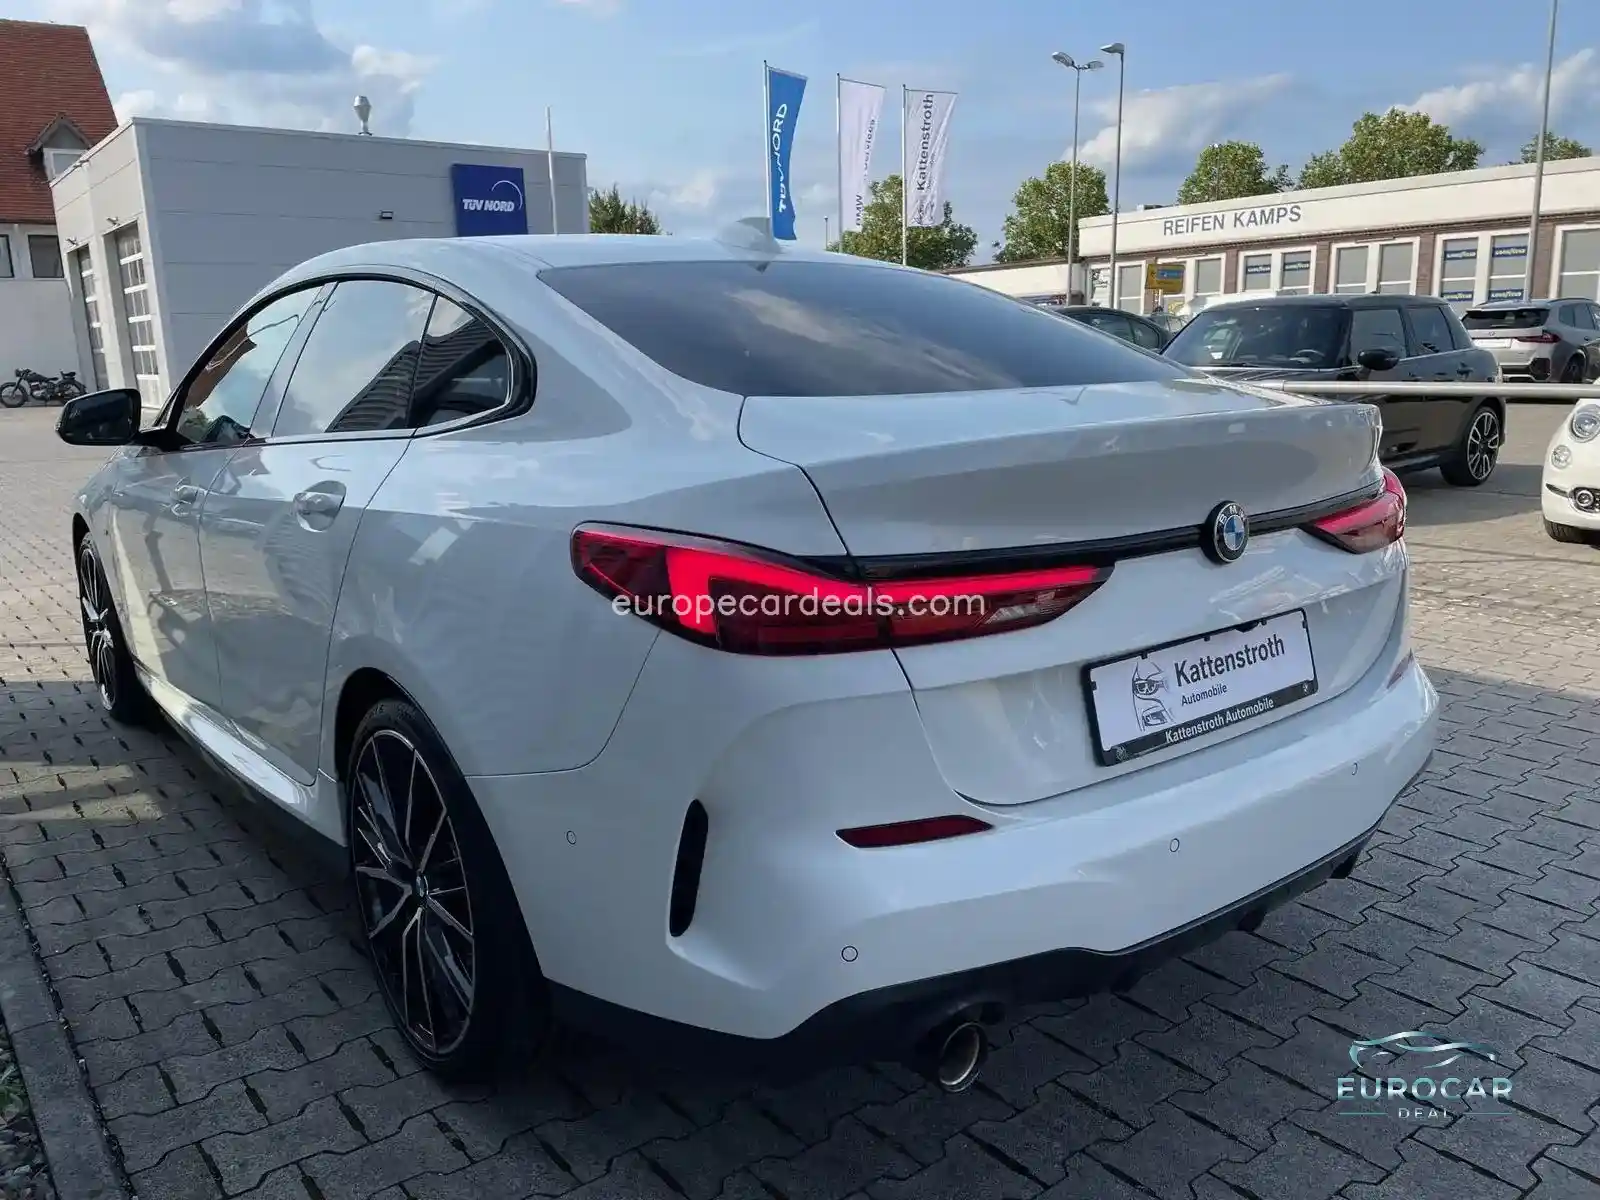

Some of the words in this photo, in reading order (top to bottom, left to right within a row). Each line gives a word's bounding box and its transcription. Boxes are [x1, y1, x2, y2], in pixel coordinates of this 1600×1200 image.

[916, 93, 935, 191] Kattenstroth
[462, 198, 484, 211] TÜV
[484, 200, 515, 212] NORD
[1163, 213, 1225, 237] REIFEN
[1233, 205, 1302, 228] KAMPS
[1174, 633, 1286, 686] Kattenstroth
[1181, 682, 1228, 706] Automobile
[1165, 714, 1225, 744] Kattenstroth
[1225, 697, 1274, 724] Automobile
